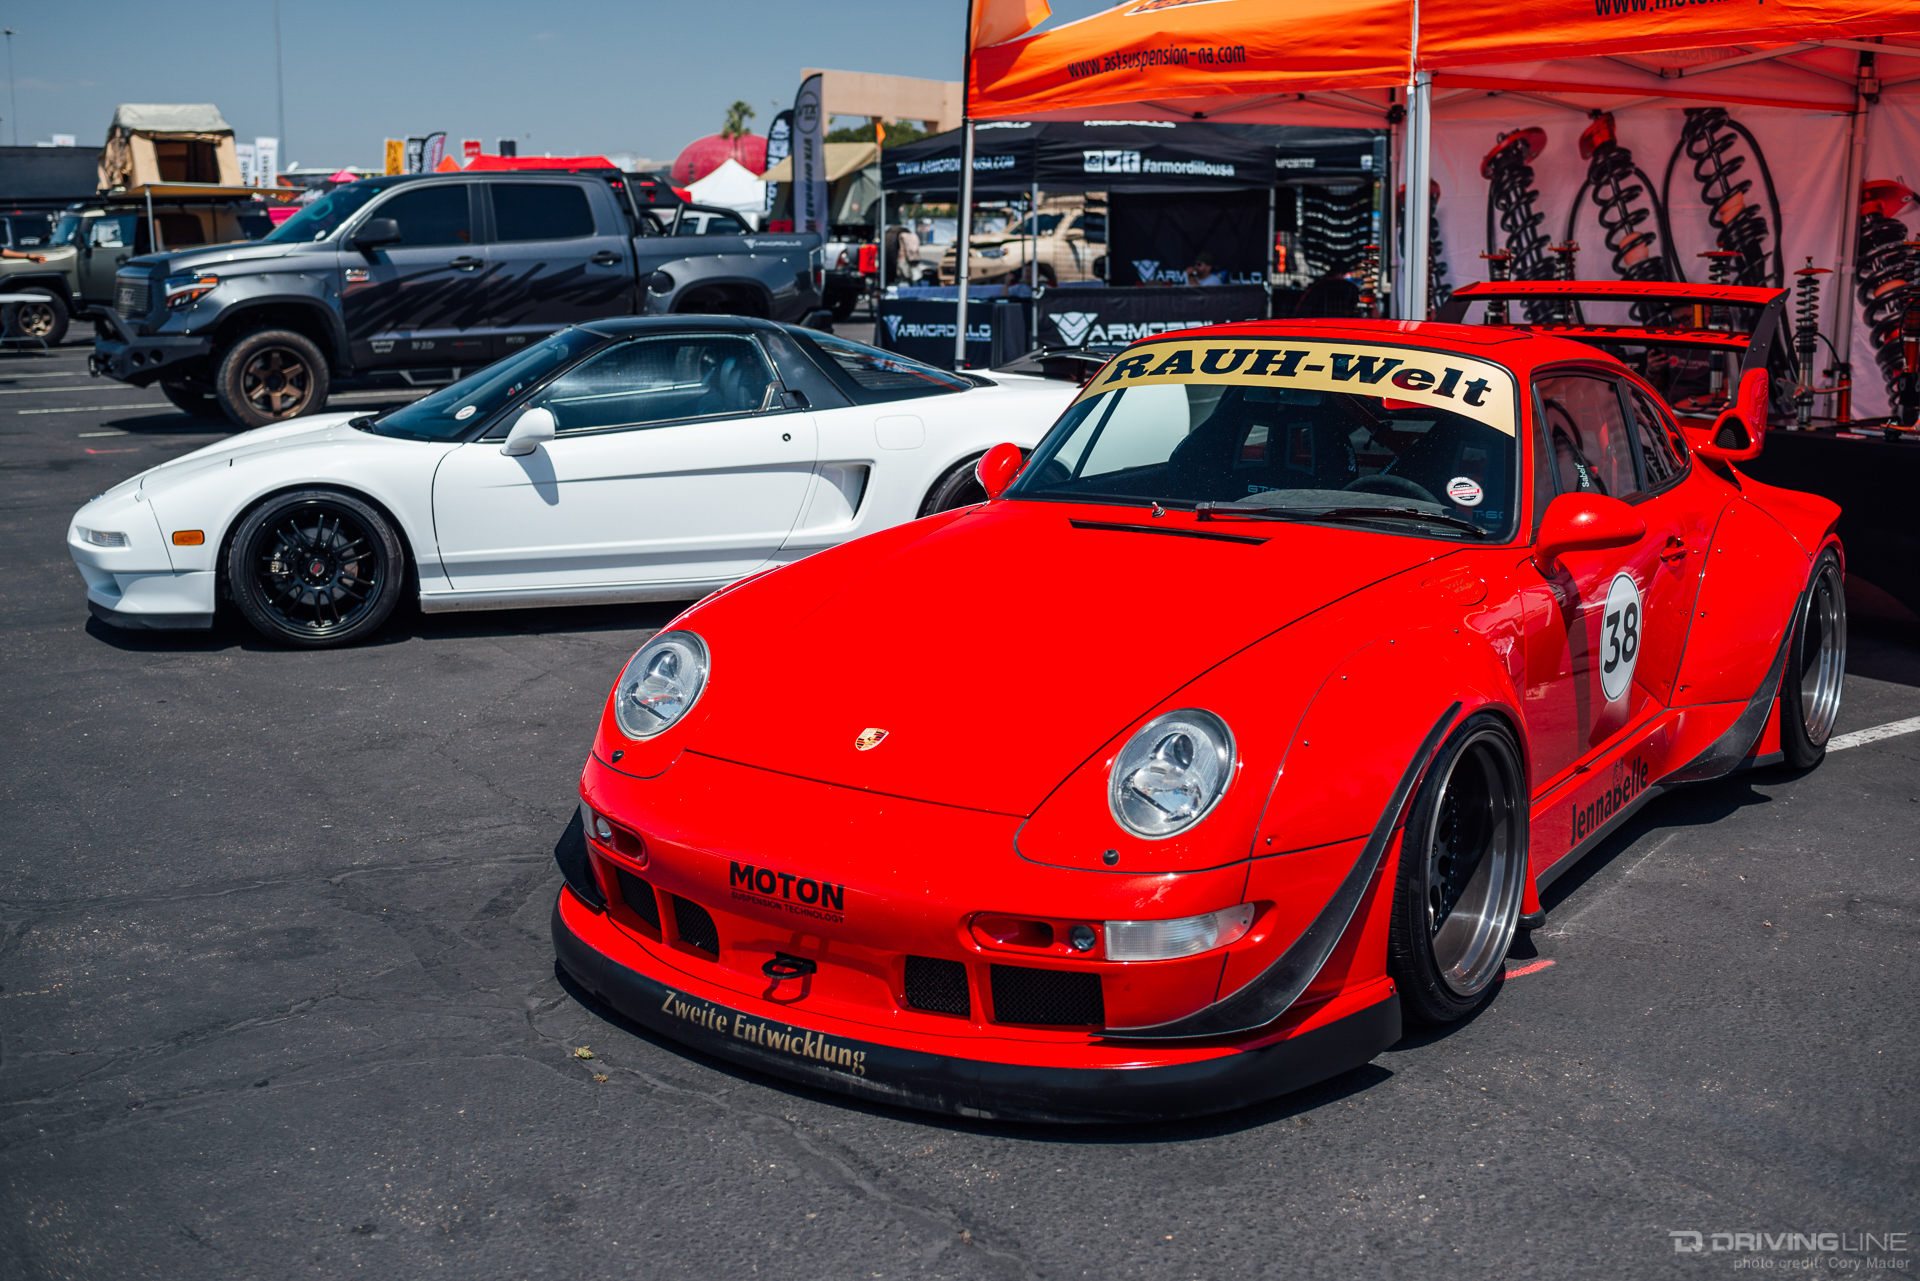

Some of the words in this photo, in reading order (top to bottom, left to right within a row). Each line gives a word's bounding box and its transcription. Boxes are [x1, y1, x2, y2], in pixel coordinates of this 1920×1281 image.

[1067, 44, 1246, 78] www.astsuspension-na.com
[1142, 159, 1235, 177] #armordillousa
[897, 324, 992, 338] ARMORDLO
[1102, 348, 1493, 408] RAUH-Welt
[1604, 602, 1638, 674] 38
[730, 860, 844, 912] MOTON
[731, 890, 782, 910] SUSPENSION
[784, 904, 844, 924] TECHNOLOGY
[661, 989, 728, 1034] Zweite
[733, 1013, 867, 1077] Entwicklung
